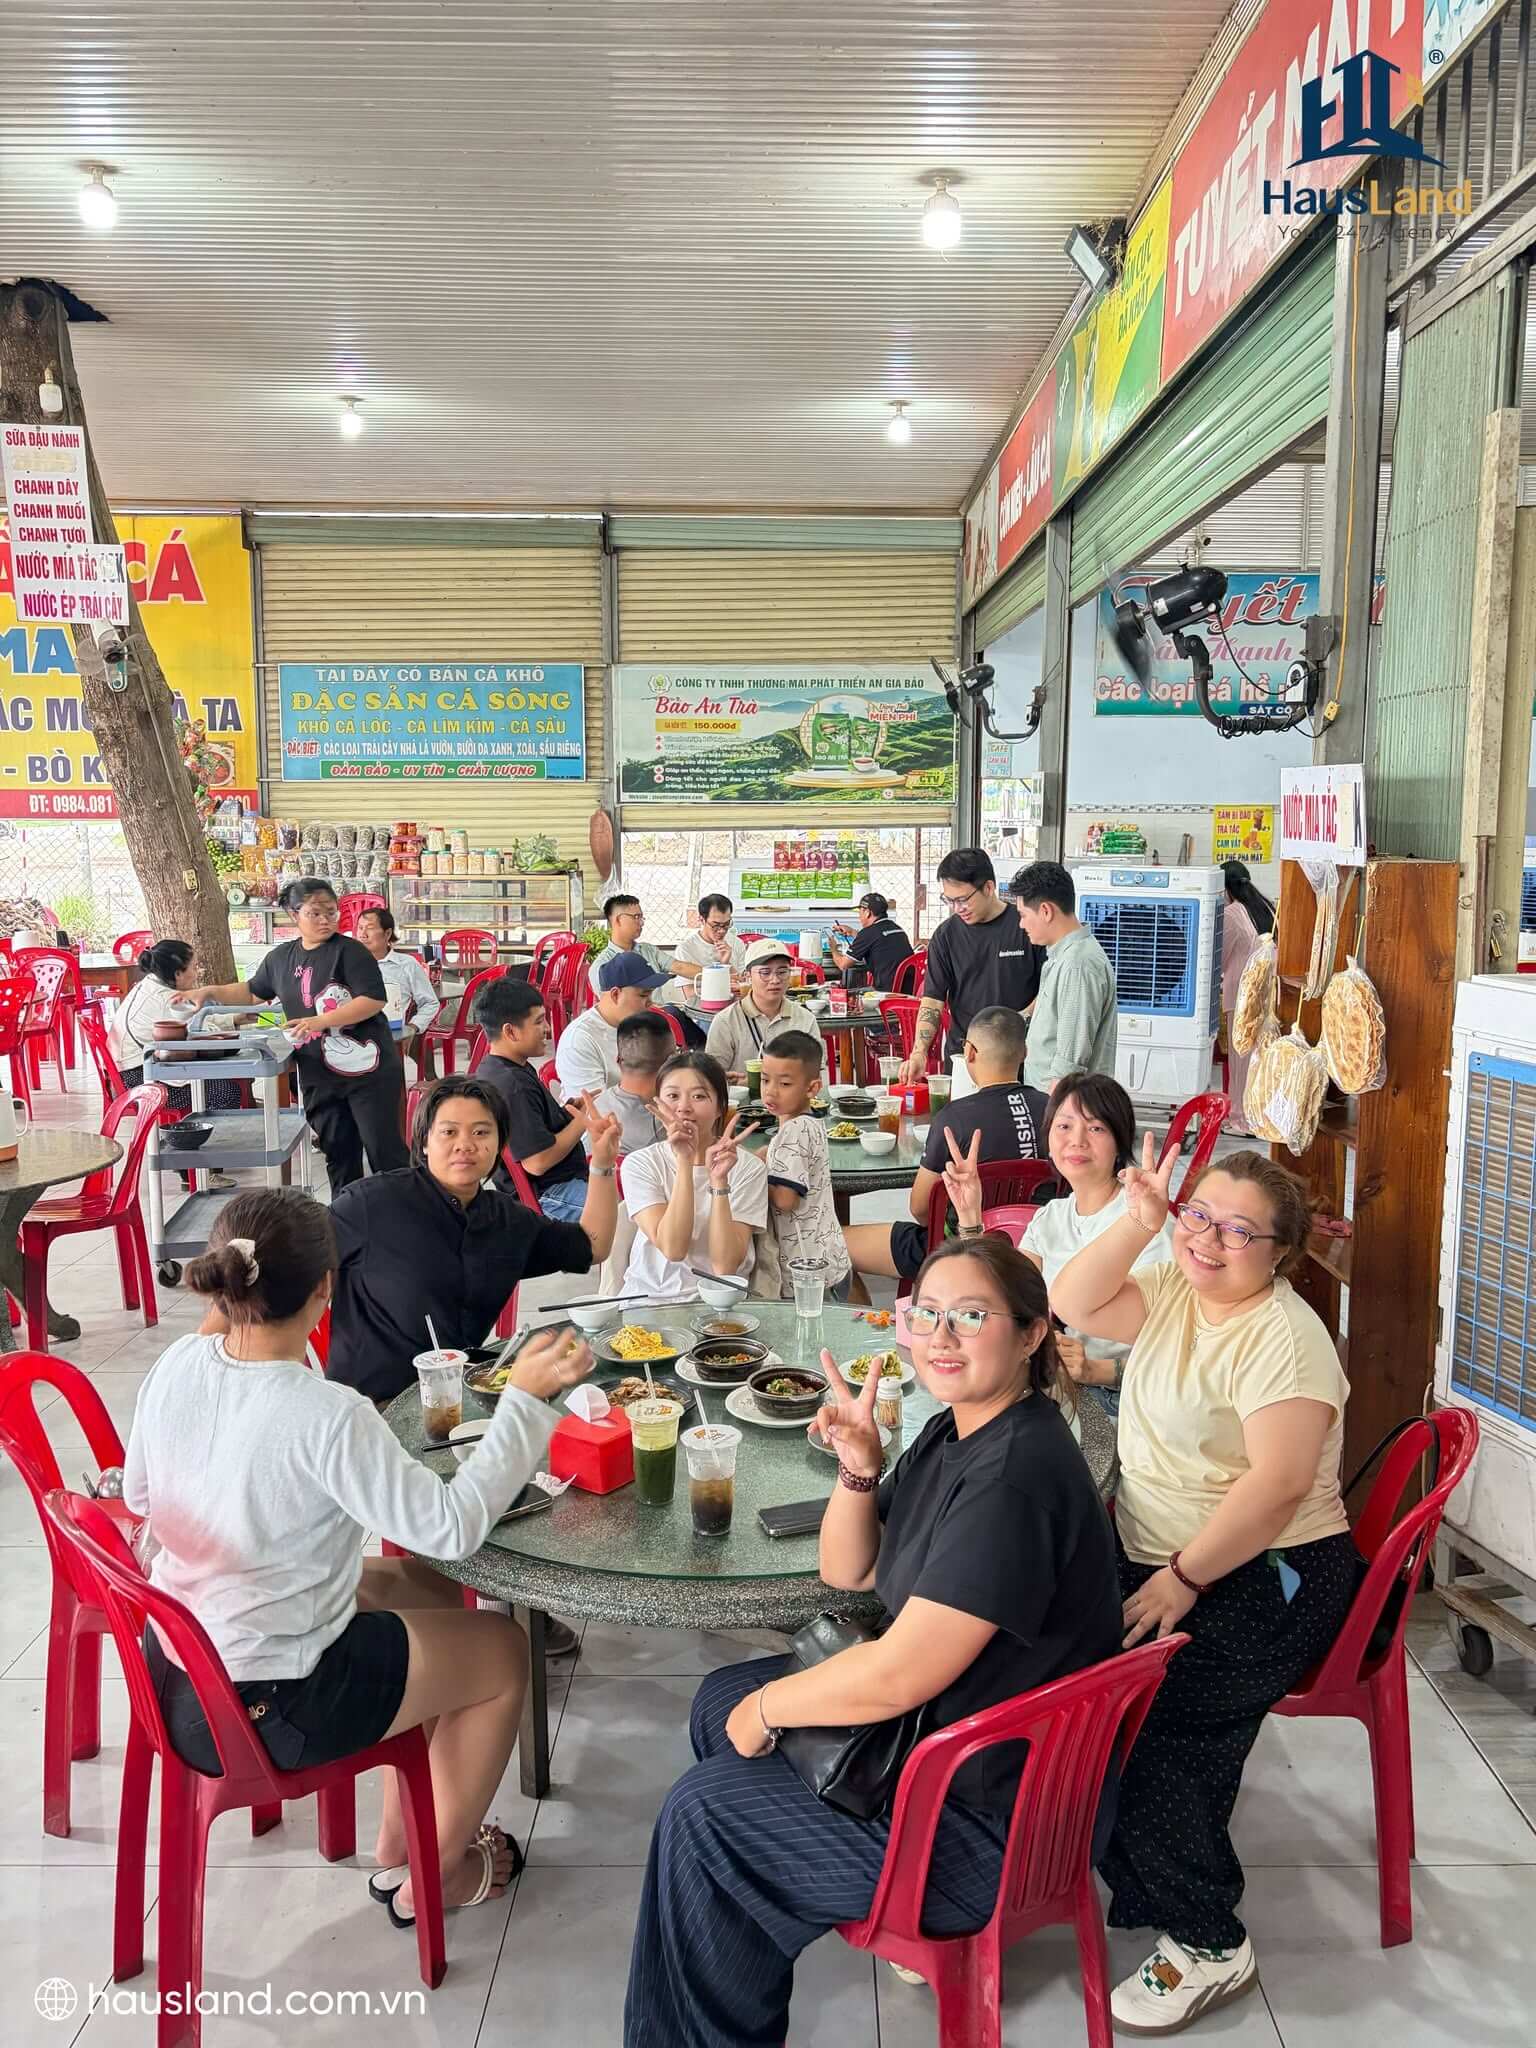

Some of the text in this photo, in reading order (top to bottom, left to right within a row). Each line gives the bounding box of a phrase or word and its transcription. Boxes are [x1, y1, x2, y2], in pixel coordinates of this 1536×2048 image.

[6, 430, 27, 447] SỮA
[29, 433, 49, 450] ĐẬU
[15, 478, 79, 496] CHANH DÂY
[14, 500, 86, 520] CHANH MUỐI
[19, 527, 86, 543] CHANH TƯƠI
[16, 550, 50, 579] NƯỚC
[53, 552, 76, 580] MÍA
[78, 548, 98, 581] TẮC
[23, 589, 122, 620] NƯỚC ÉP TRÁI CÂY
[316, 665, 545, 684] TẠI ĐÂY CÓ BÁN CÁ KHÔ
[675, 676, 702, 689] CÔNG
[705, 679, 715, 688] TY
[719, 679, 744, 689] TNHH
[748, 679, 786, 689] THƯƠNG
[810, 677, 834, 689] PHÁT
[838, 675, 866, 688] TRIỂN
[869, 679, 883, 688] AN
[885, 679, 901, 688] GIA
[904, 676, 924, 688] BẢO
[1096, 674, 1142, 701] Các
[291, 683, 572, 715] ĐẶC SẢN CÁ SÔNG
[655, 695, 759, 715] Bảo An Trà
[203, 697, 243, 732] TA
[335, 716, 355, 733] CÁ
[510, 717, 529, 733] CÁ
[28, 748, 71, 783] BÒ
[331, 760, 363, 777] ĐẢM
[364, 760, 391, 776] BẢO
[403, 764, 422, 776] UY
[424, 762, 445, 776] TÍN
[457, 759, 492, 776] CHẤT
[493, 764, 537, 779] LƯỢNG
[1283, 784, 1303, 840] NƯỚC
[1305, 784, 1320, 841] MÍA
[1217, 839, 1229, 848] CAM
